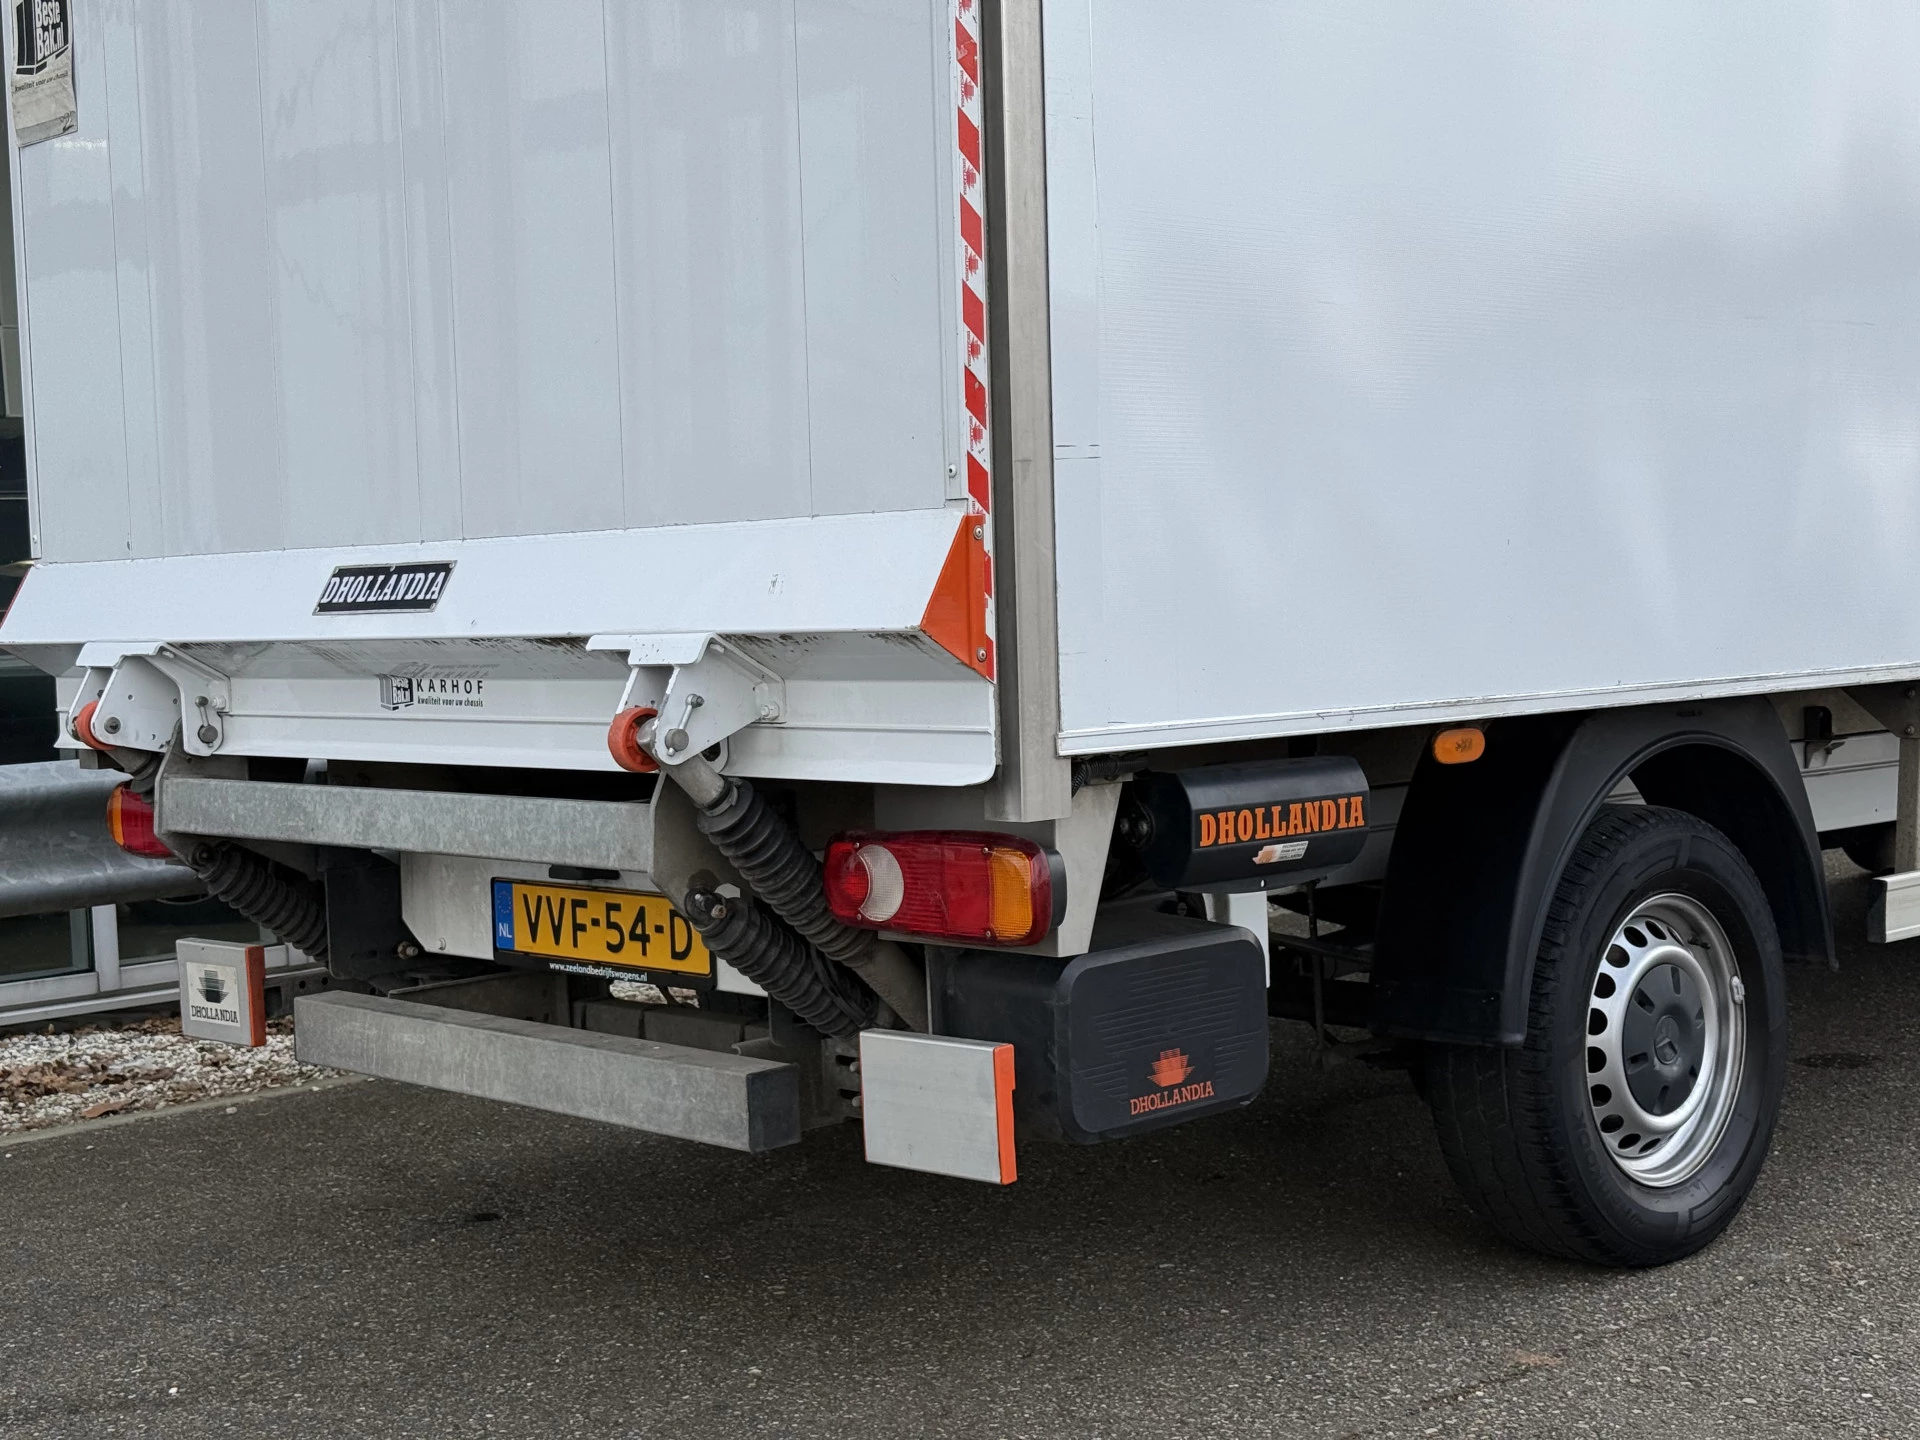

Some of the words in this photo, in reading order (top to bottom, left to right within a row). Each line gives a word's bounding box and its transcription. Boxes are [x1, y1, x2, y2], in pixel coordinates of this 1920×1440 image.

[35, 0, 61, 28] Beste
[36, 21, 64, 61] Bak.nl
[320, 571, 446, 604] DHOLLANDIA
[416, 678, 484, 695] KARHOF
[417, 695, 440, 705] kwaliteit
[442, 698, 454, 706] voor
[464, 697, 483, 707] chassis
[1200, 796, 1365, 847] DHOLLANDIA
[499, 922, 512, 938] NL
[523, 893, 693, 960] VVF-54-D
[549, 962, 648, 982] www.zeelandbedrijfswagens.nl
[191, 1005, 238, 1023] DHOLLANDIA
[1129, 1080, 1215, 1115] DHOLLANDIA
